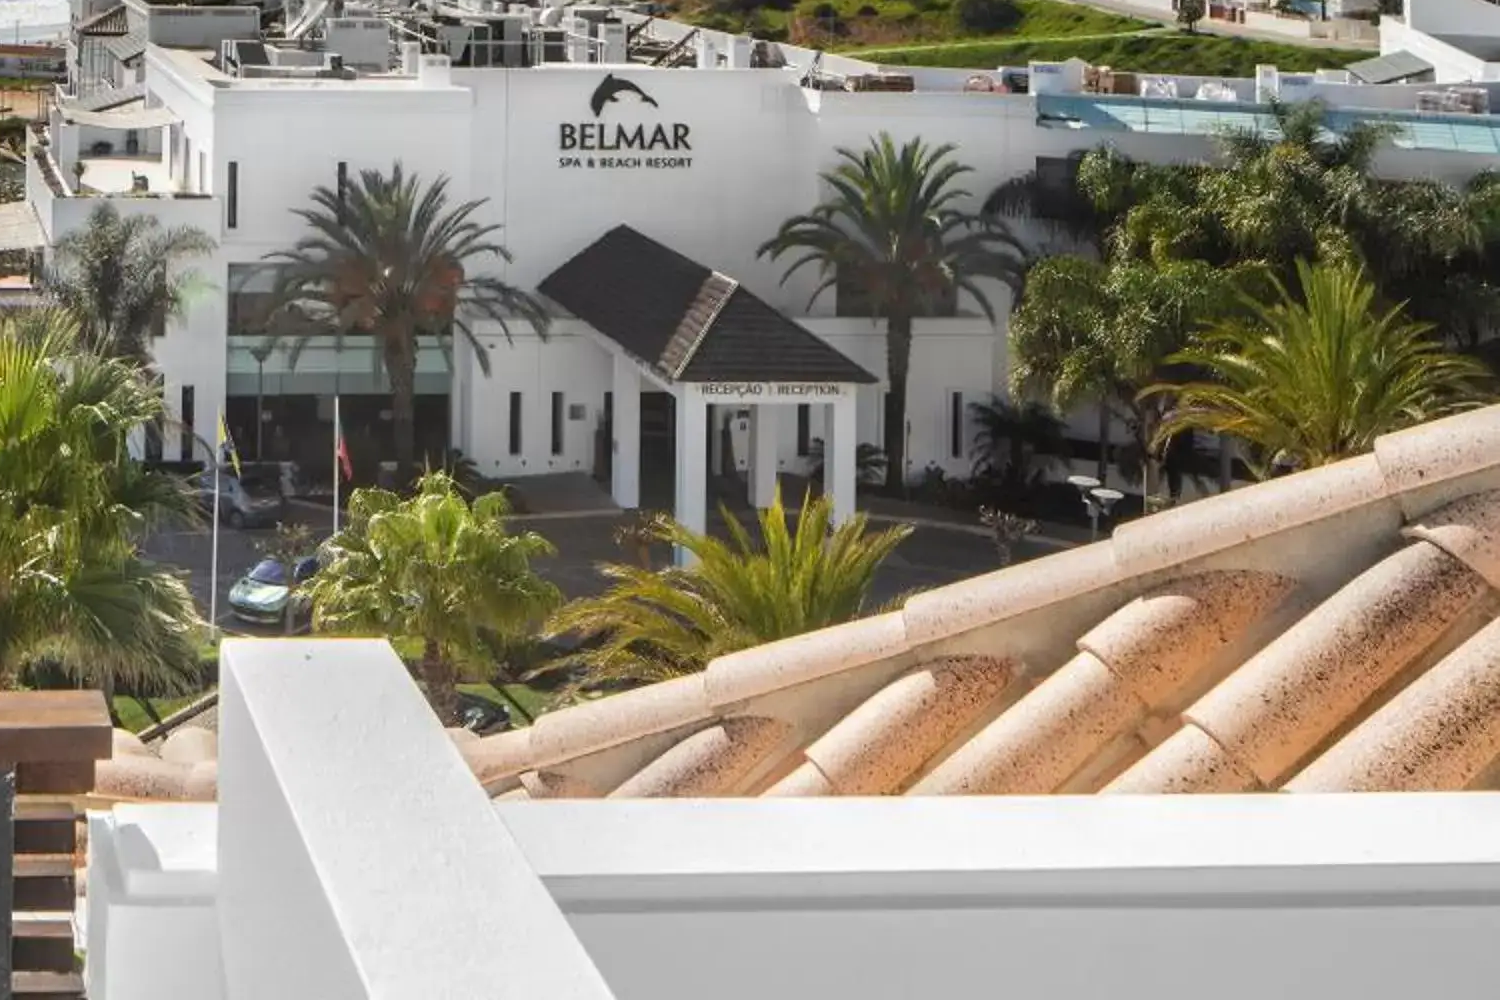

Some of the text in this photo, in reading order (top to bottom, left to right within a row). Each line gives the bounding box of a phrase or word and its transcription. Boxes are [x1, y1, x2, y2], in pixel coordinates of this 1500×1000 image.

[559, 122, 692, 150] BELMAR
[559, 157, 582, 168] SPA
[600, 157, 641, 168] BEACH
[646, 157, 693, 168] RESORT
[777, 384, 840, 395] RECEPTION
